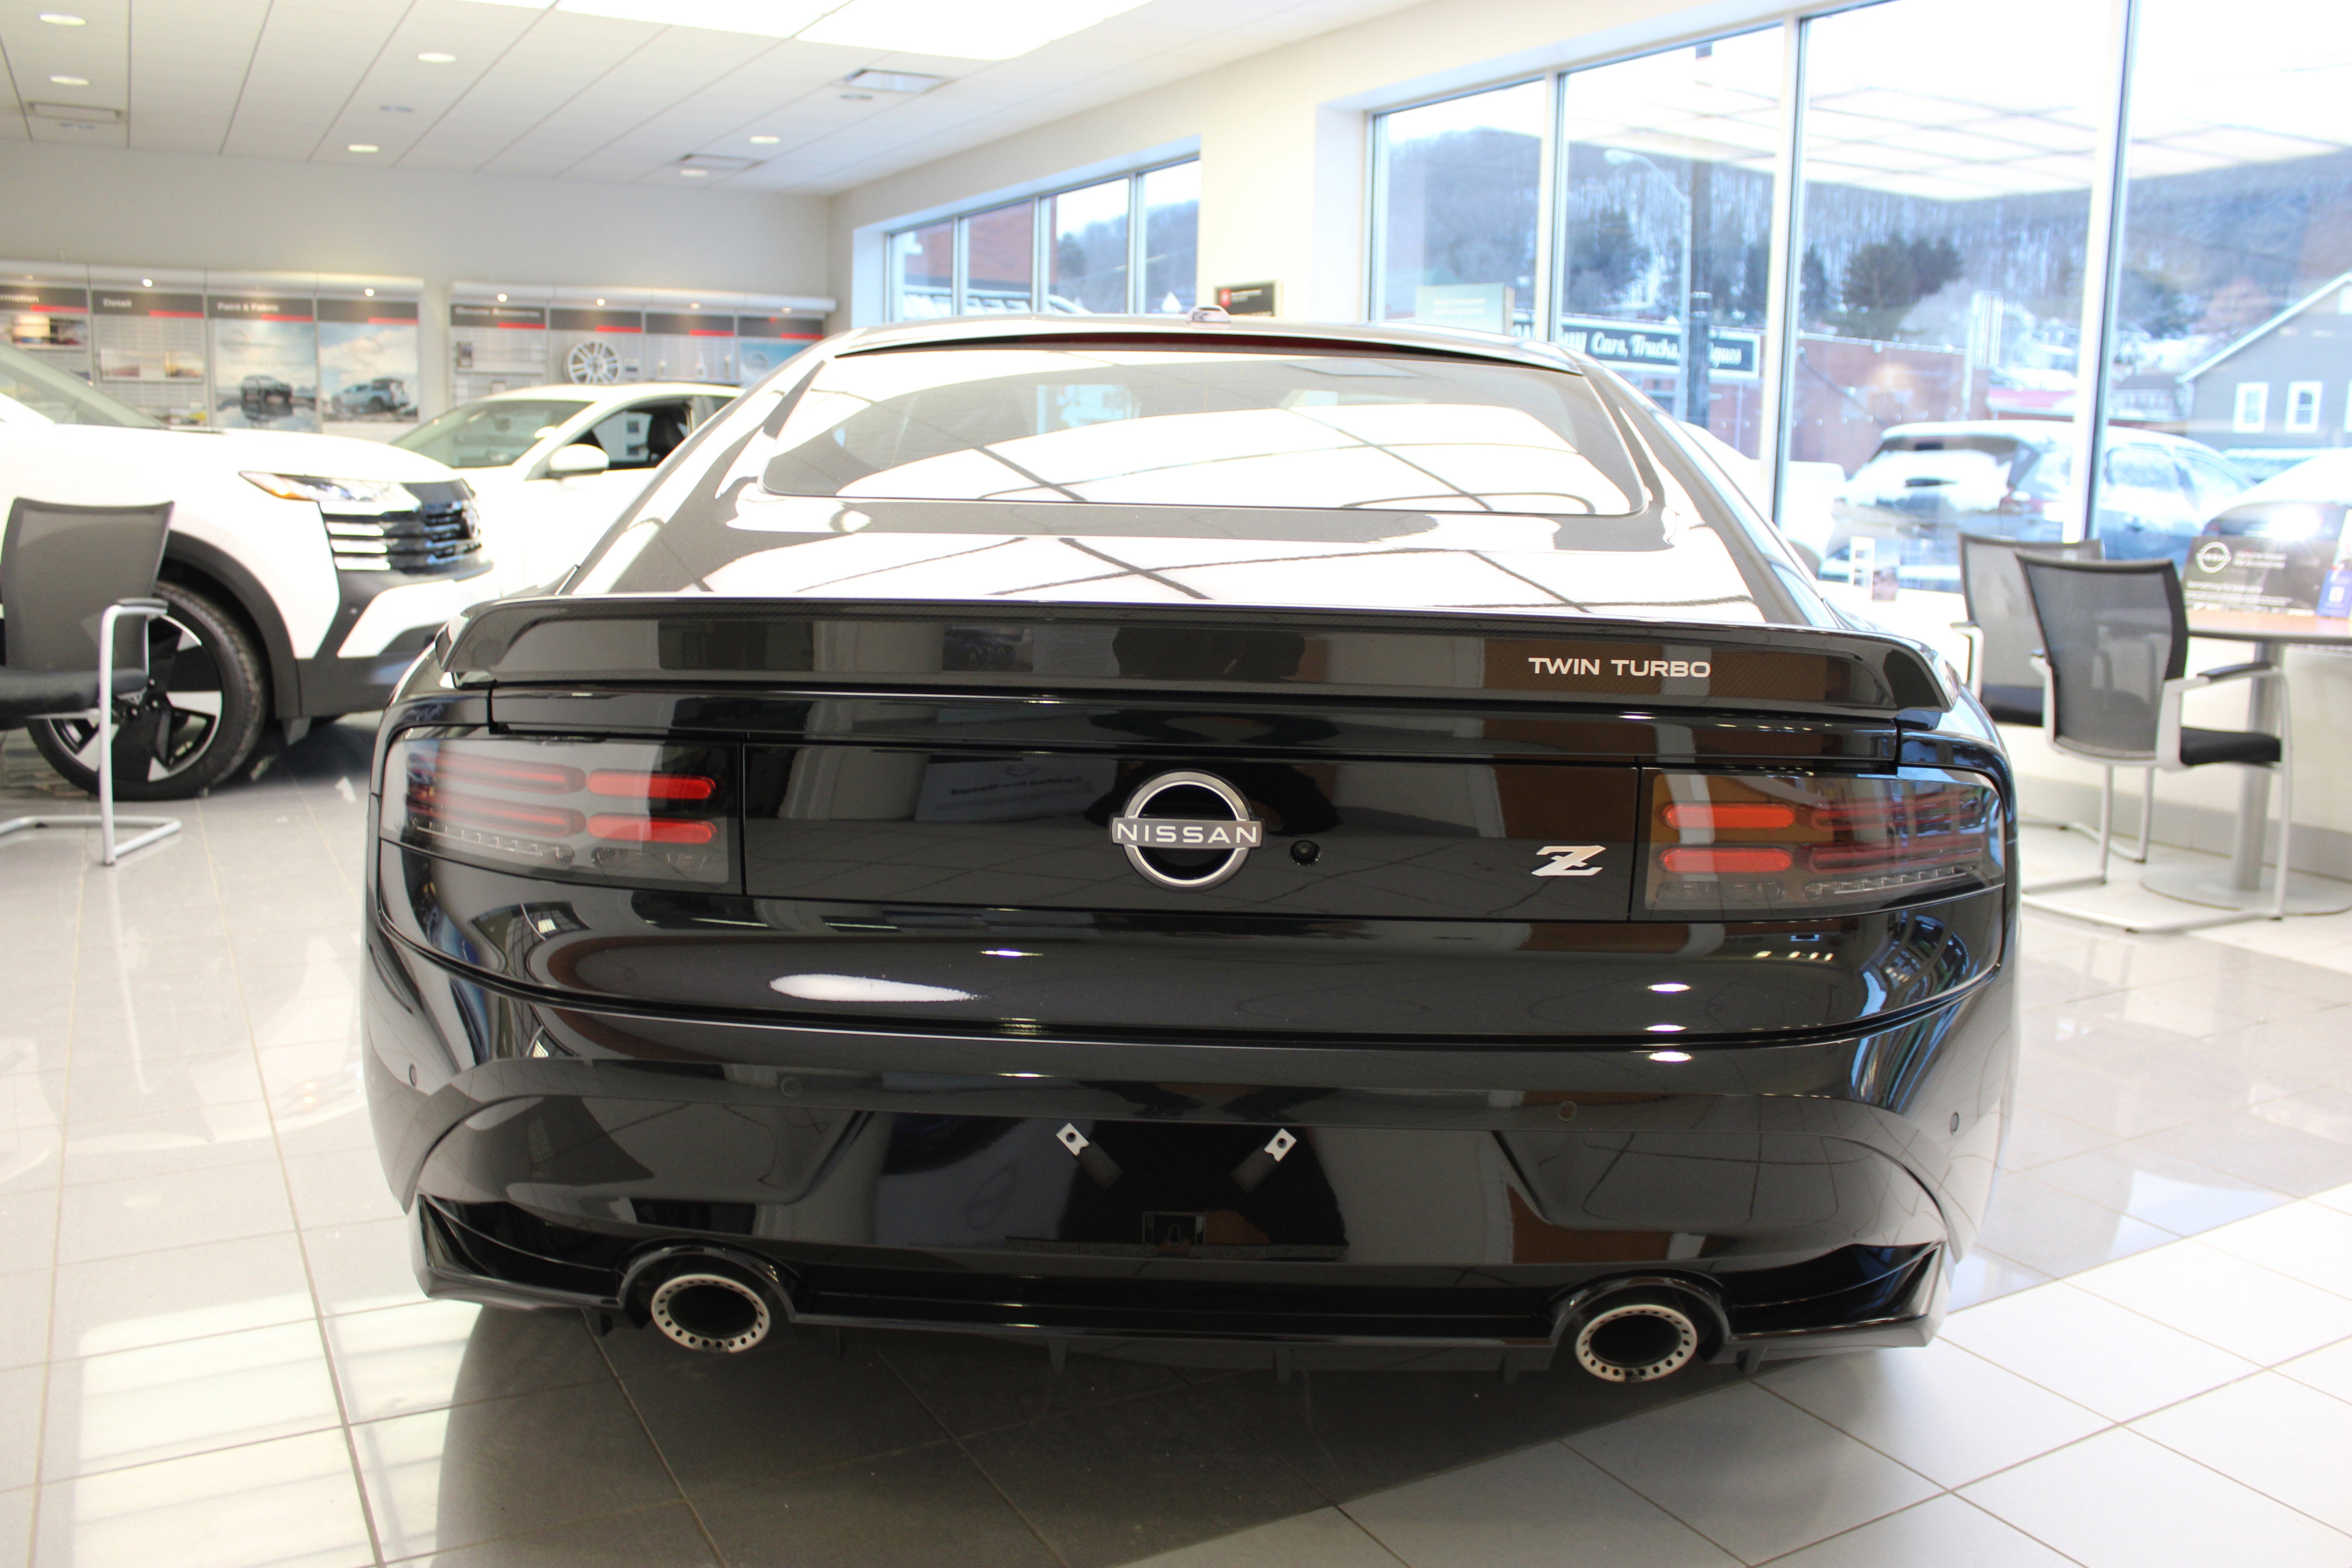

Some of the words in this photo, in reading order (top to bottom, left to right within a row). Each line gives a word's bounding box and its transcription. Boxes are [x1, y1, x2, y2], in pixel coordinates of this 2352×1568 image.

[1591, 331, 1628, 358] Cars,
[1528, 657, 1600, 675] TWIN
[1610, 659, 1711, 678] TURBO
[1117, 822, 1257, 844] NISSAN
[1531, 845, 1606, 877] Z
